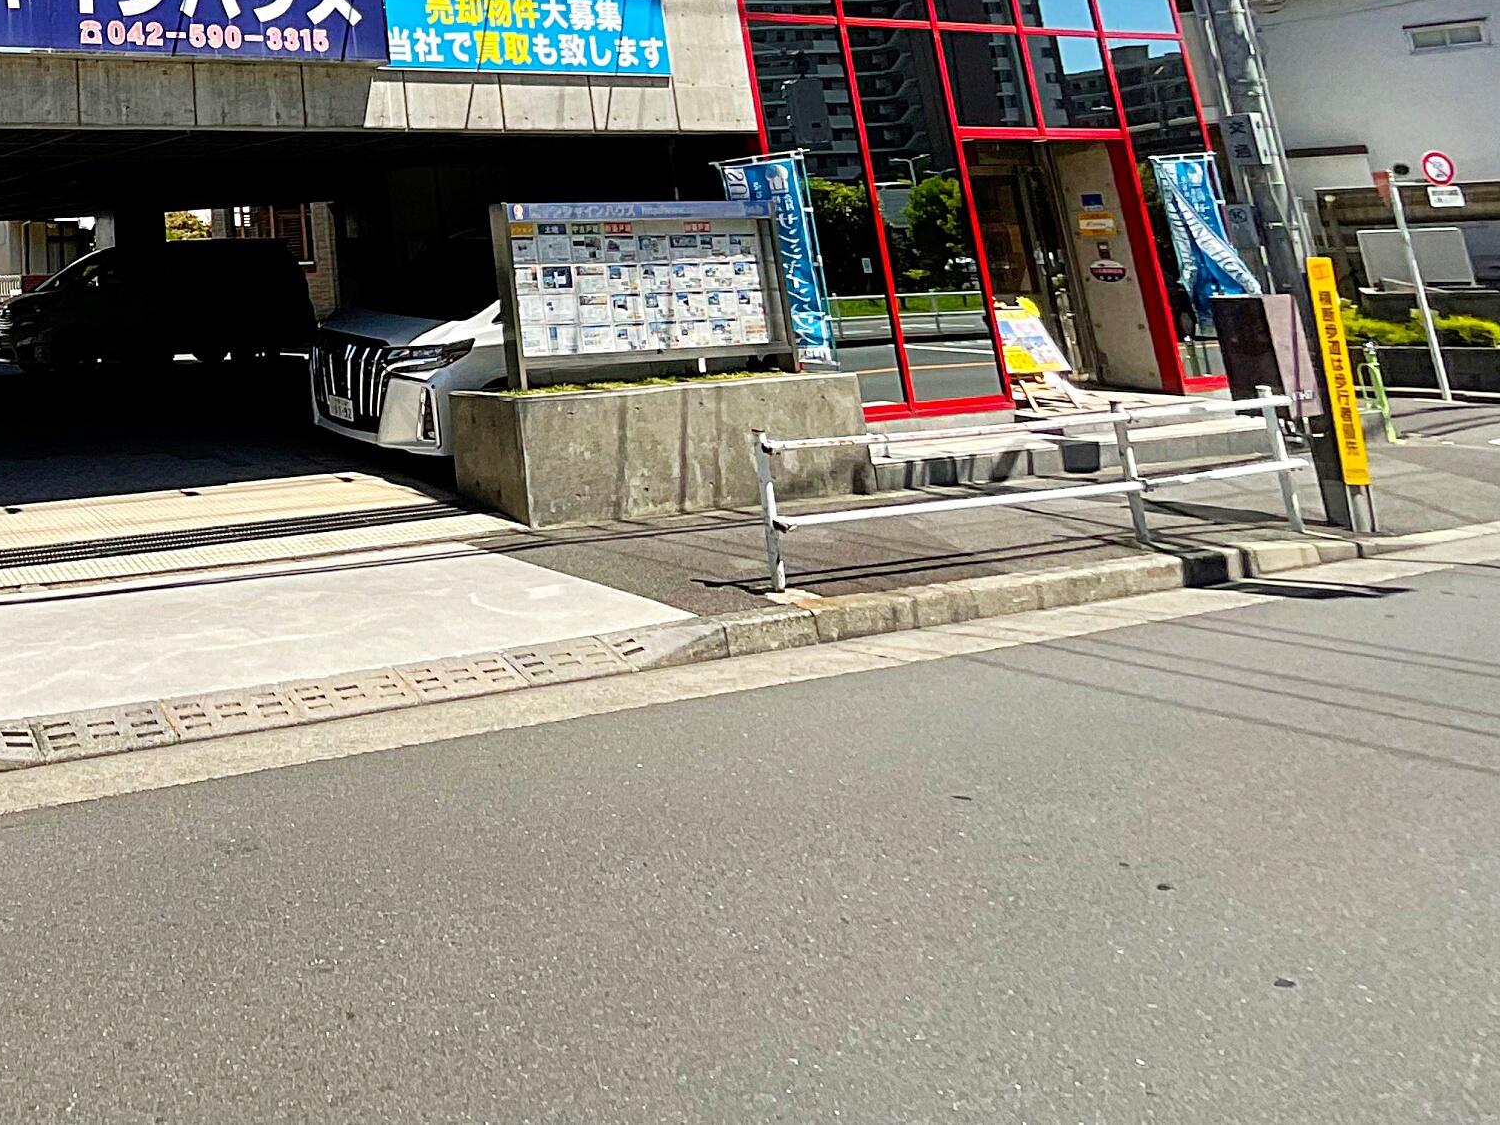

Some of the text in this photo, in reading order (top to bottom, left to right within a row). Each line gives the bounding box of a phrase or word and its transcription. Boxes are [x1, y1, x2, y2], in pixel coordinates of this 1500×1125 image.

[388, 27, 665, 69] 当社で買取も致します
